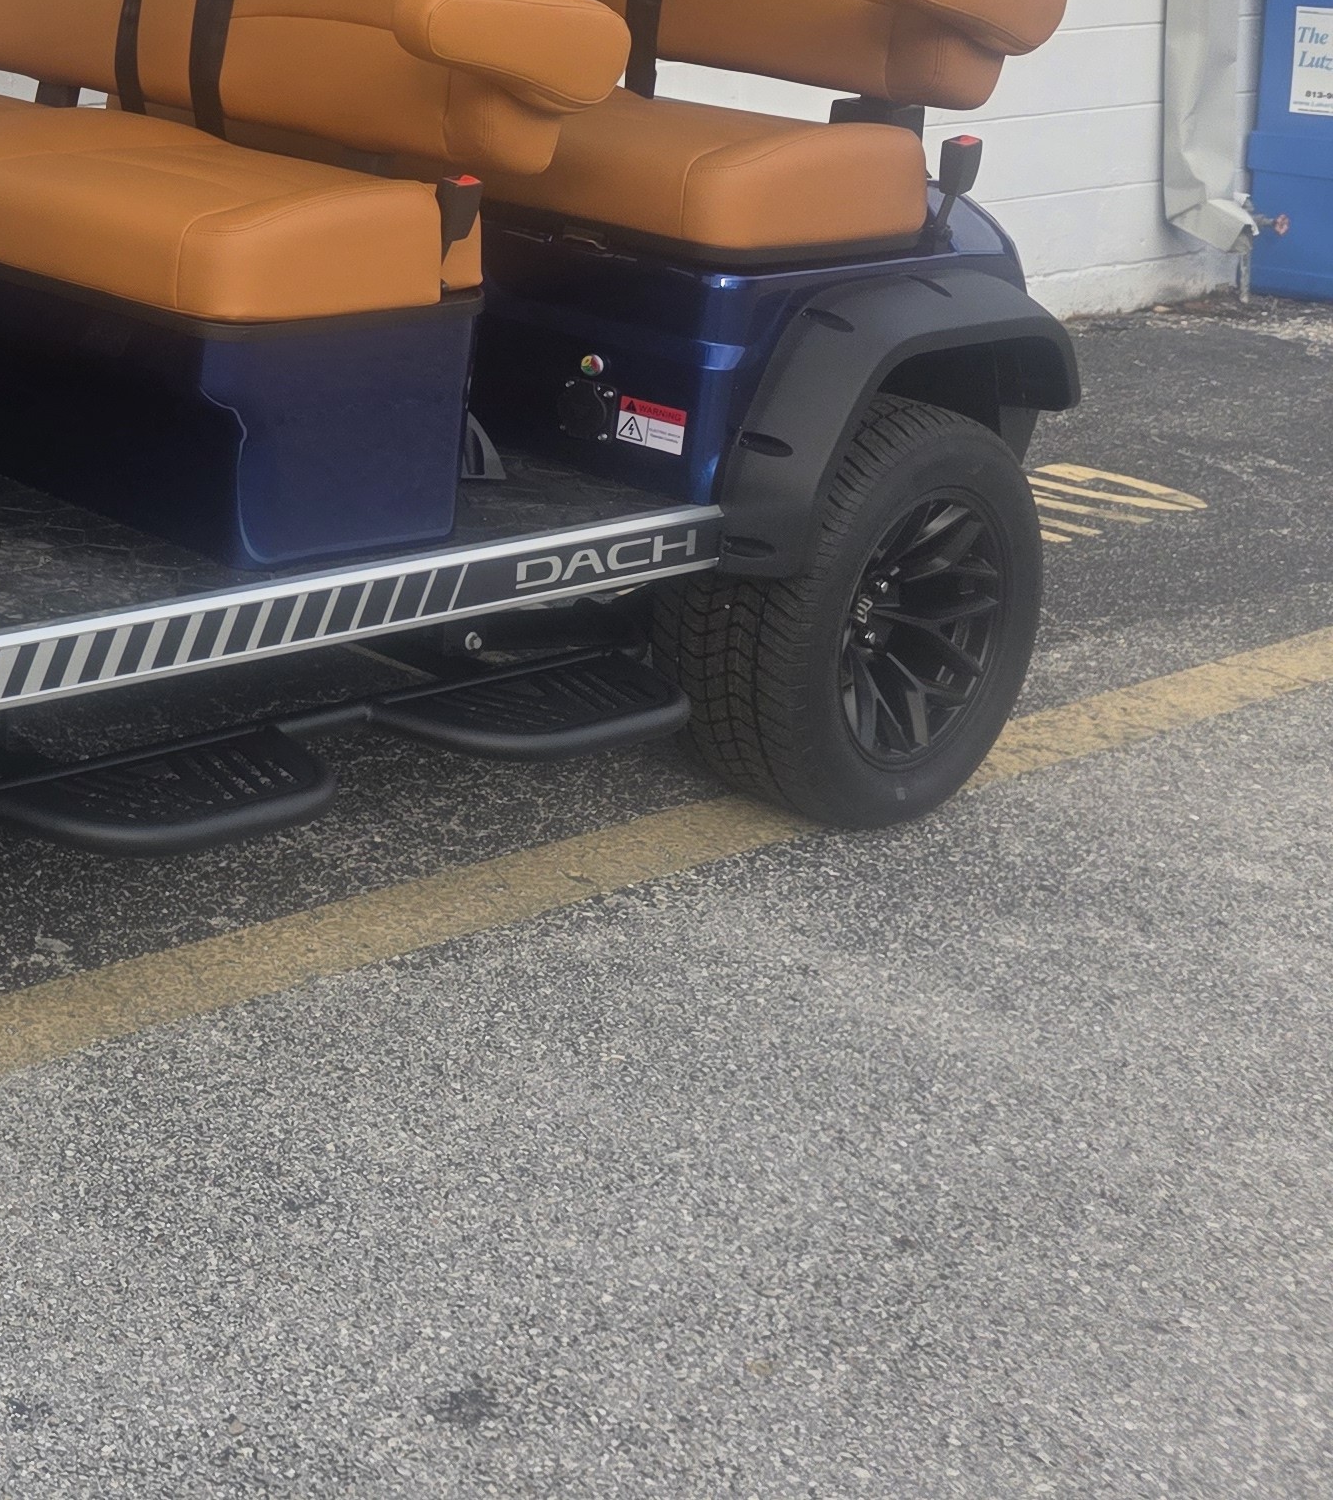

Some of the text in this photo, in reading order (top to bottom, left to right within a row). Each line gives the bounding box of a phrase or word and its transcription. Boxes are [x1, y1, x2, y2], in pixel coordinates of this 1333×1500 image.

[1298, 26, 1330, 45] The
[1298, 50, 1333, 70] Lutz
[638, 403, 683, 422] WARNING
[515, 529, 697, 590] DACH
